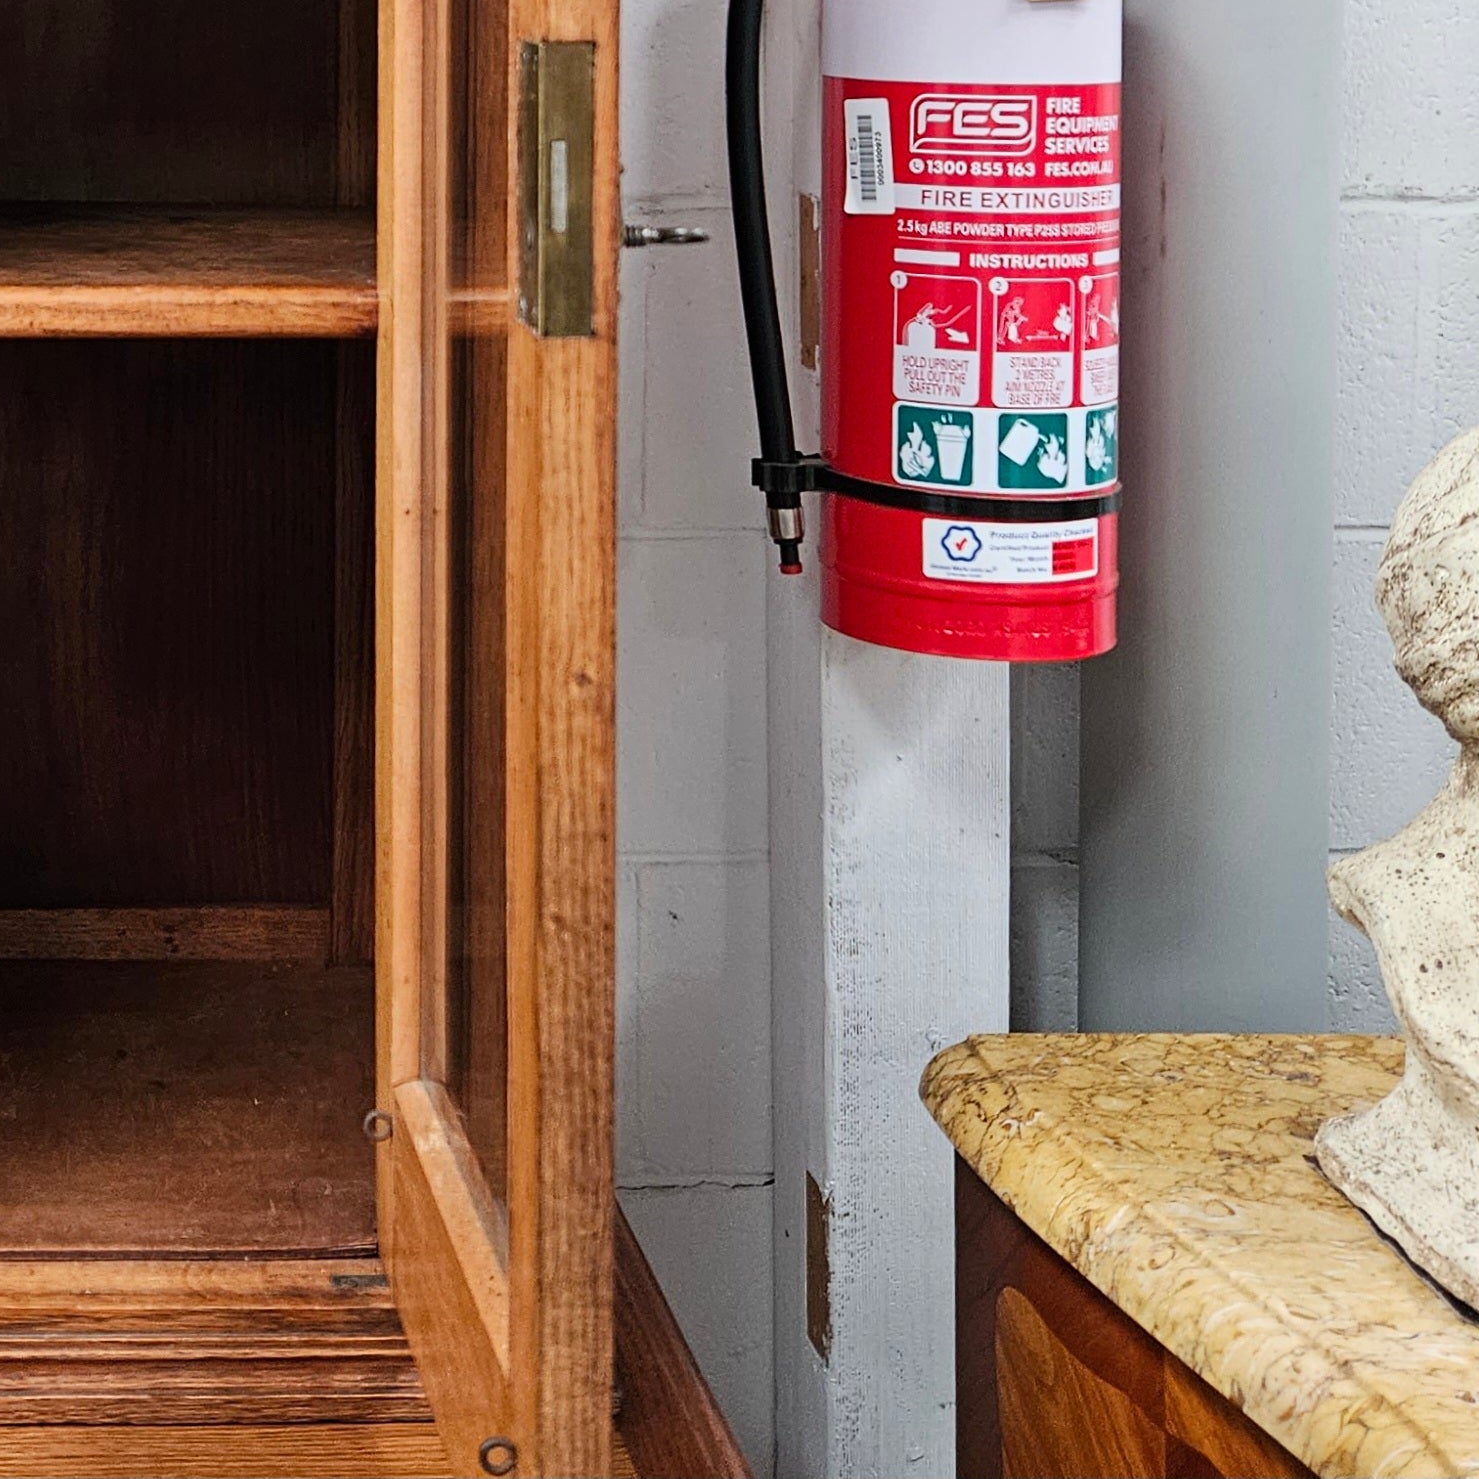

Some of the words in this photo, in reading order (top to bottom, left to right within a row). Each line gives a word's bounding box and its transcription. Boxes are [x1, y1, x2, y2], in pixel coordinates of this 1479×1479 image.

[1046, 97, 1081, 115] FIRE
[917, 101, 1030, 137] FES
[1045, 136, 1110, 154] SERVICES
[926, 159, 967, 175] 1300
[970, 161, 1002, 176] 855
[1007, 162, 1036, 177] 163
[921, 189, 972, 208] FIRE
[981, 189, 1113, 210] EXTINGUISHER
[929, 221, 952, 235] ABE
[953, 222, 1005, 237] POWDER
[1005, 223, 1033, 237] TYPE
[969, 253, 1088, 269] INSTRUCTIONS
